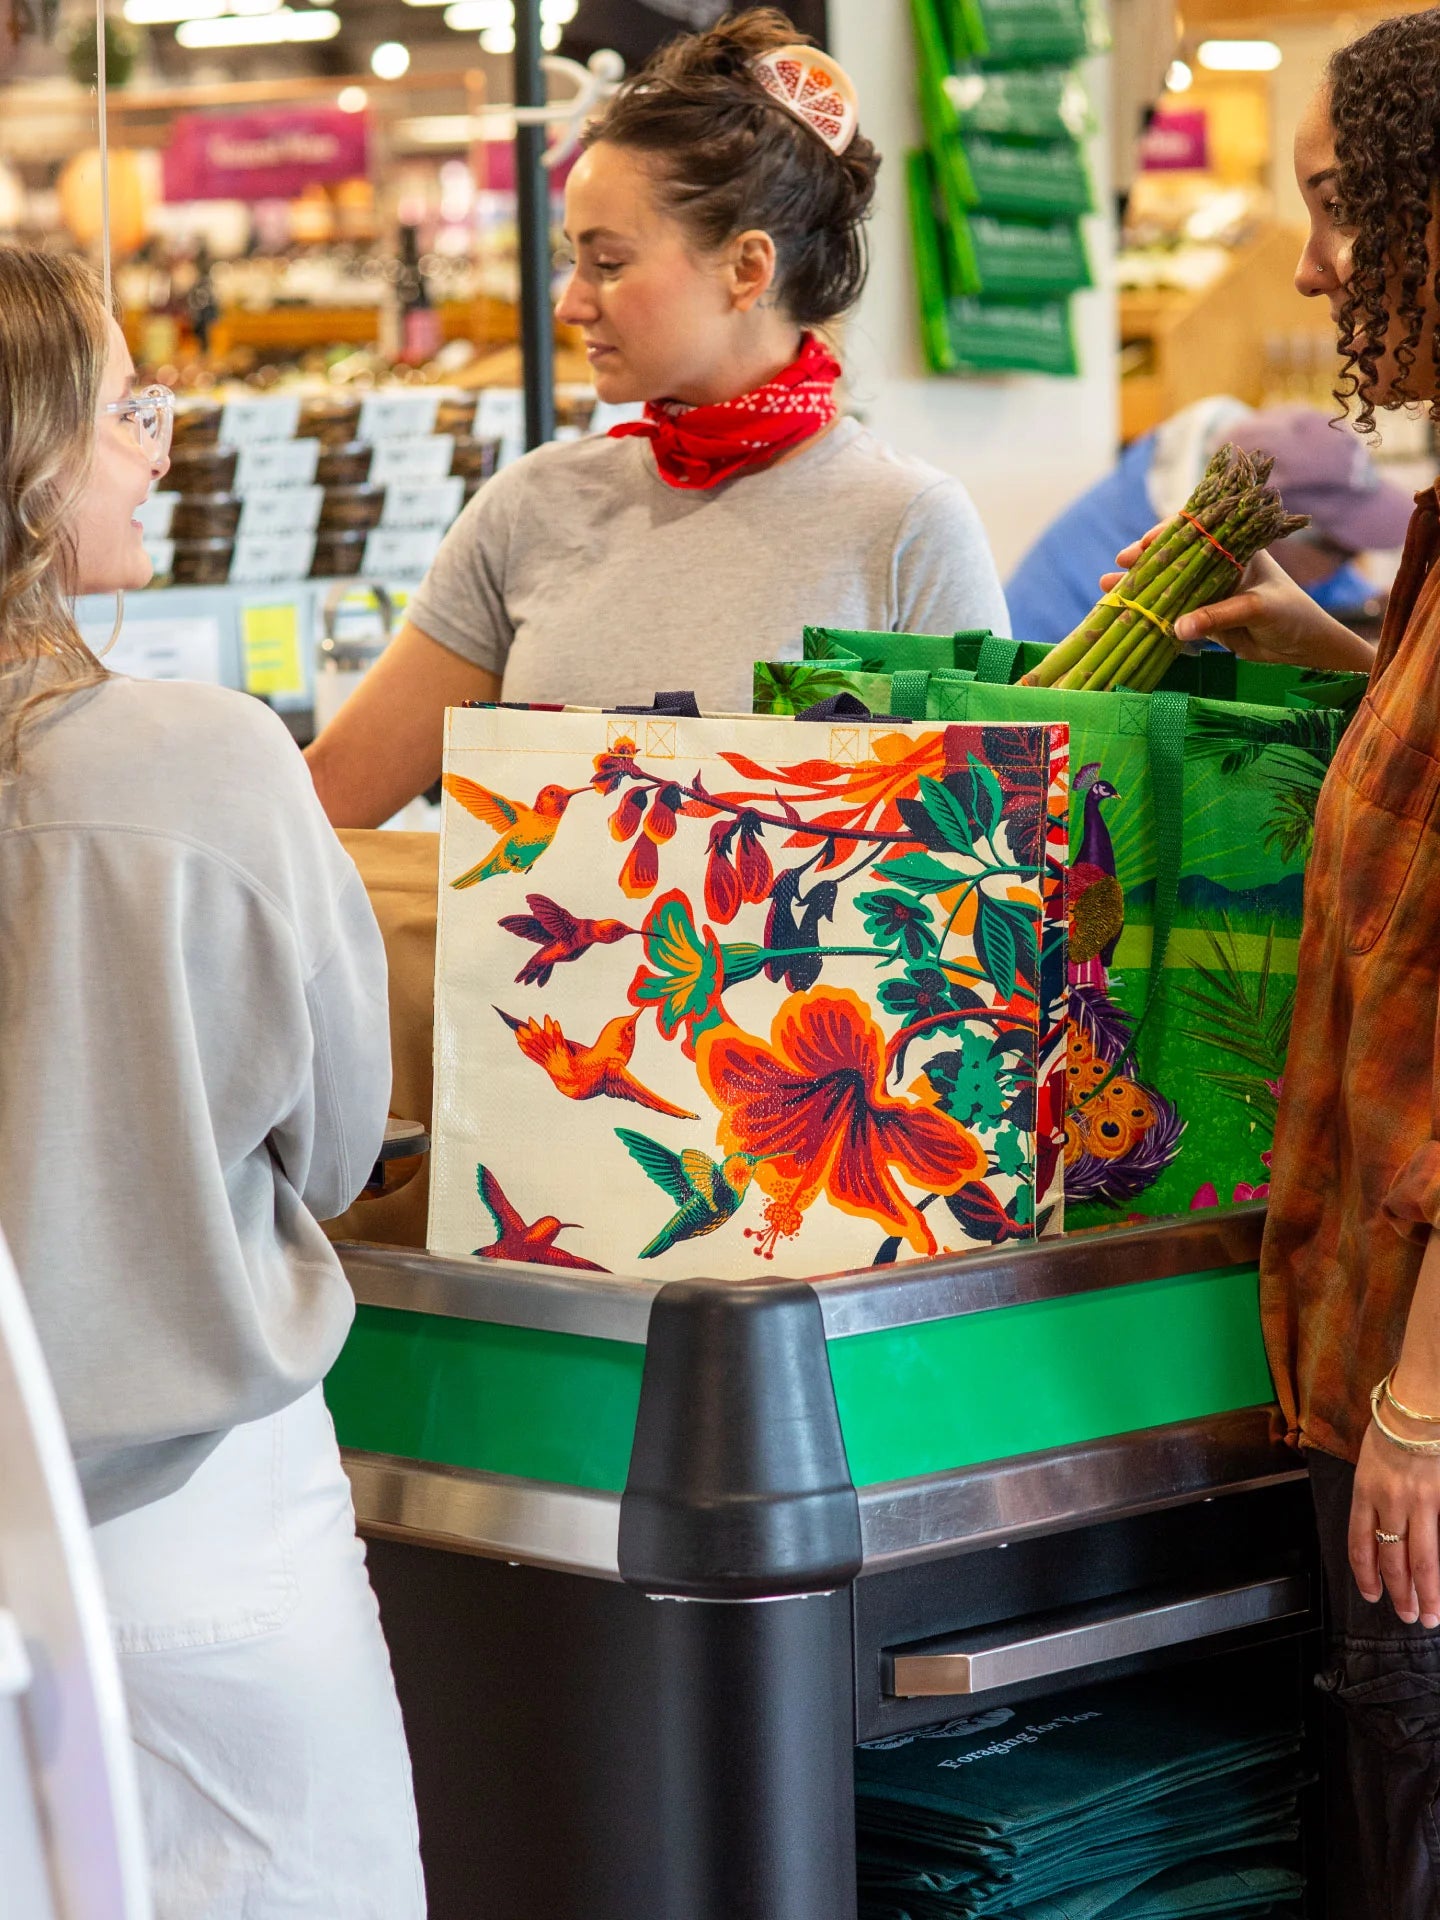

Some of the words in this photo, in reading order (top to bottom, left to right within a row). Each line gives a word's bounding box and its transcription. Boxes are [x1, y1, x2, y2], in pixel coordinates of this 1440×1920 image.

[937, 1732, 1038, 1770] Foraging
[1025, 1722, 1062, 1734] for
[1053, 1711, 1103, 1724] You
